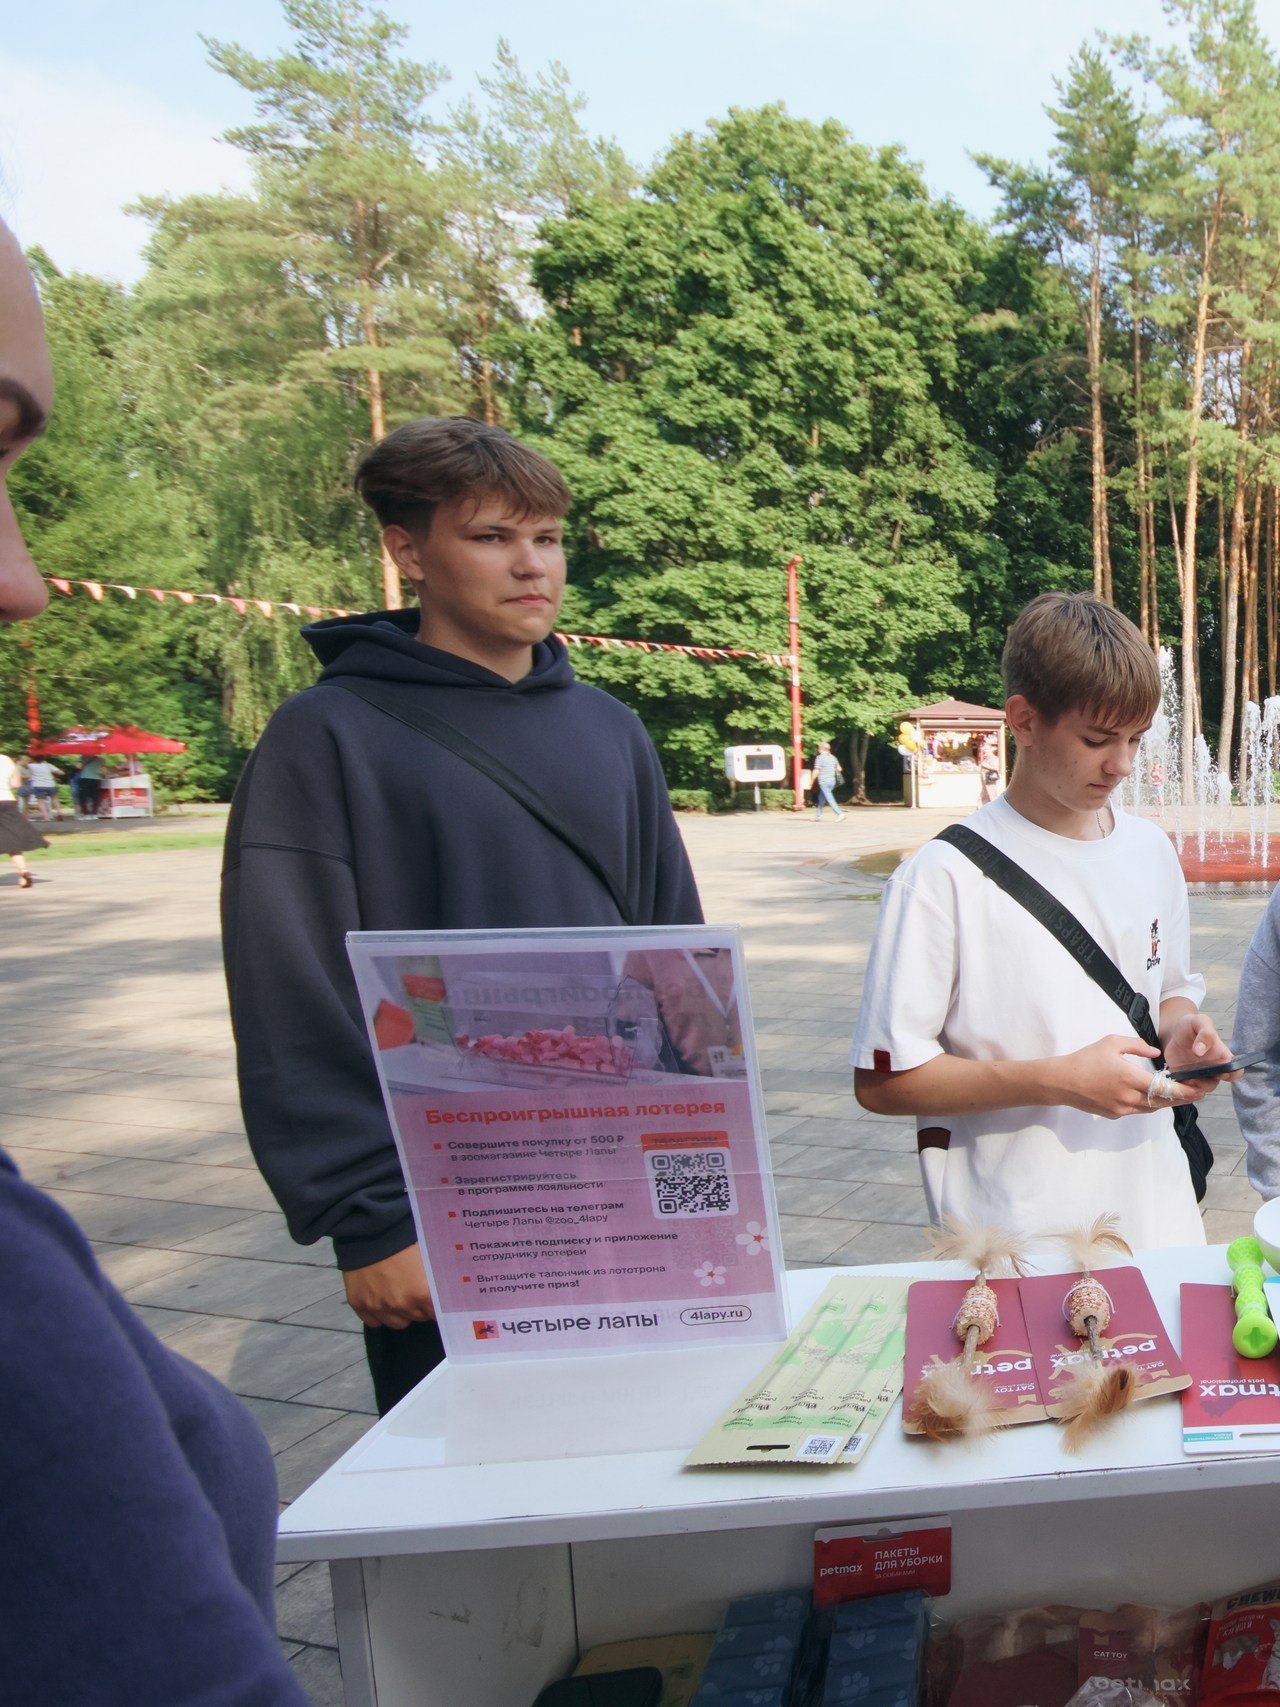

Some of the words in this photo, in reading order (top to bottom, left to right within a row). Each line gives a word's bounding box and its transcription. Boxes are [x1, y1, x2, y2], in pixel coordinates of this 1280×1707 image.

[425, 1108, 629, 1125] Беспроигрышная
[634, 1102, 725, 1118] лотерея
[448, 1139, 520, 1150] Совершите
[522, 1137, 572, 1149] покупку
[574, 1137, 587, 1145] от
[590, 1135, 614, 1144] 500
[460, 1150, 536, 1162] зоомагазине
[455, 1172, 577, 1186] Зарегистрируйтесь
[458, 1188, 465, 1196] в
[467, 1183, 535, 1197] программе
[537, 1180, 603, 1193] лояльности
[462, 1205, 548, 1219] Подпишитесь
[566, 1201, 624, 1213] телеграм
[465, 1218, 509, 1229] Четыре
[512, 1217, 543, 1226] Лапы
[545, 1213, 608, 1226] @zoo_4lapy
[470, 1239, 532, 1251] Покажите
[535, 1237, 591, 1249] подписку
[604, 1232, 678, 1244] приложение
[472, 1251, 538, 1263] сотруднику
[540, 1248, 586, 1259] лотереи
[477, 1271, 536, 1283] Вытащите
[539, 1268, 590, 1278] талончик
[608, 1265, 666, 1275] лототрона
[489, 1282, 545, 1294] получите
[547, 1279, 580, 1290] приз!
[690, 1308, 743, 1321] 4lapy.ru
[502, 1315, 591, 1335] четыре
[598, 1313, 658, 1330] лапы
[874, 1547, 919, 1559] ПАКЕТЫ
[820, 1564, 862, 1576] petmax
[874, 1560, 897, 1571] ДЛЯ
[900, 1555, 943, 1568] УБОРКИ
